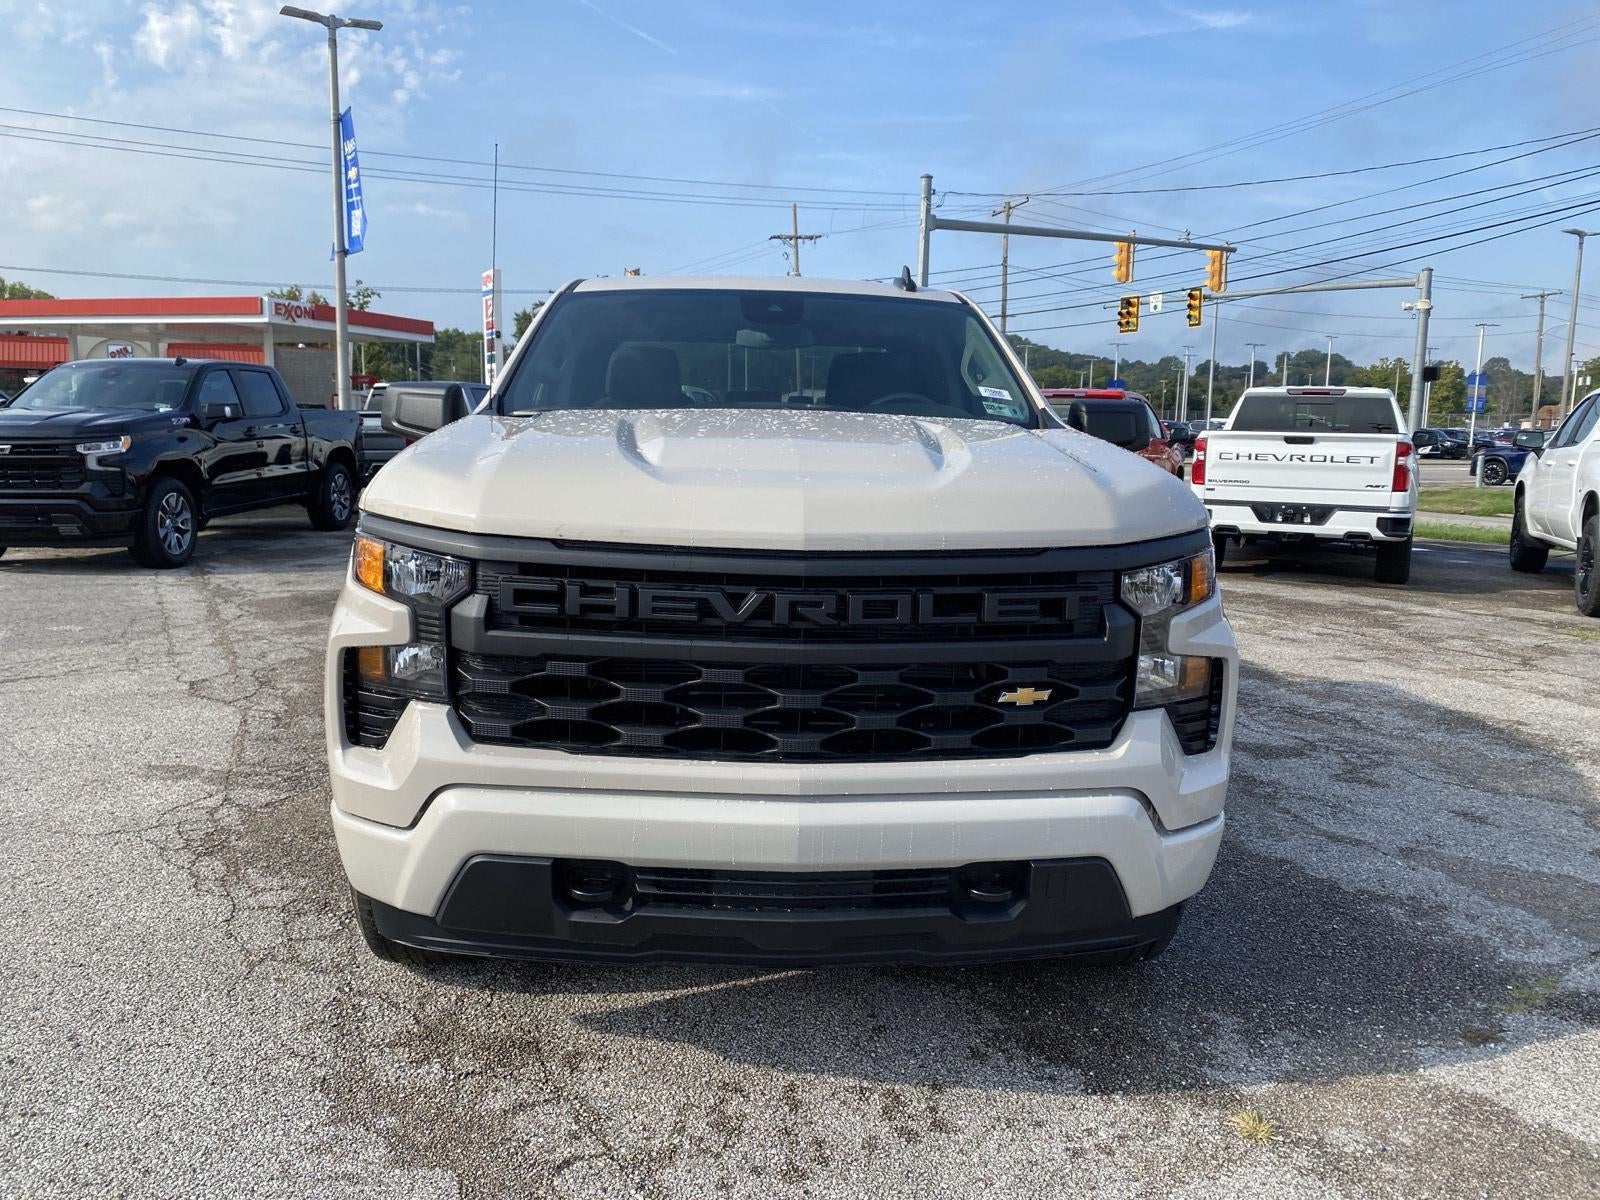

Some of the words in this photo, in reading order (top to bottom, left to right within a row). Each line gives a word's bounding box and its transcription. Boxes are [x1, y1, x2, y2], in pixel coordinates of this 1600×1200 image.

[272, 301, 316, 323] EXXON
[1218, 452, 1381, 465] CHEVROLET
[500, 580, 1097, 627] CHEVROLET
